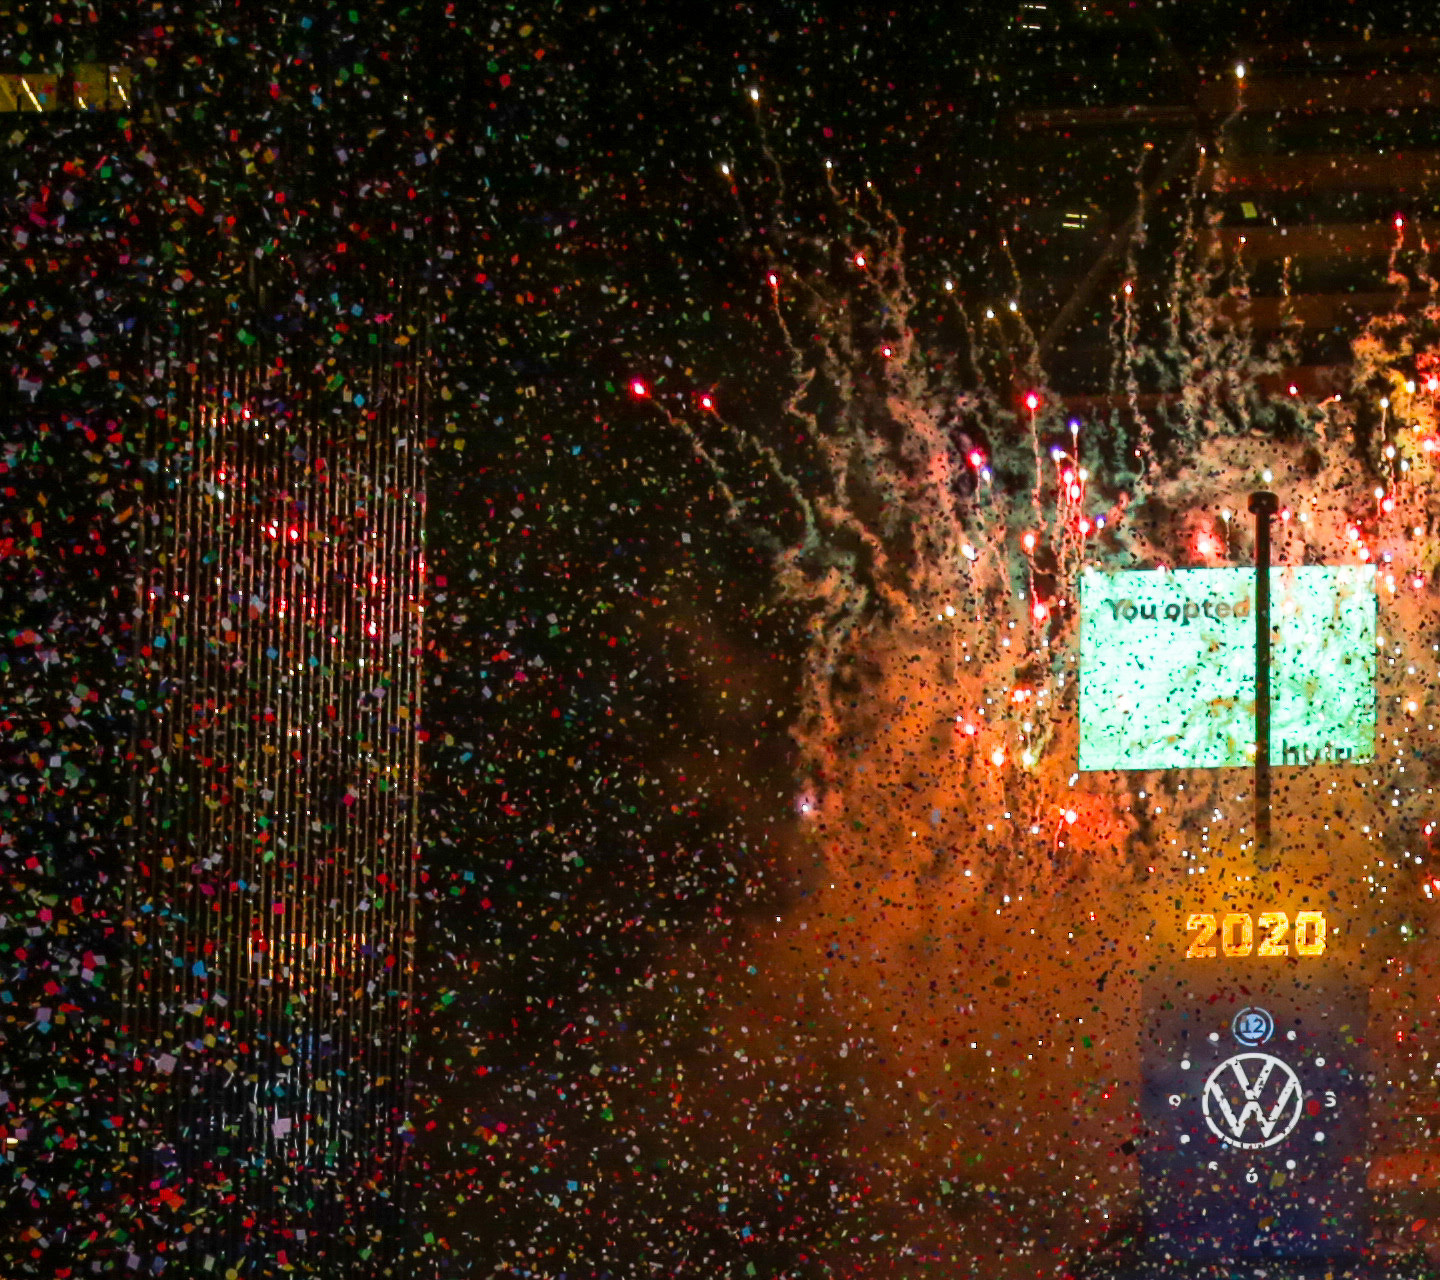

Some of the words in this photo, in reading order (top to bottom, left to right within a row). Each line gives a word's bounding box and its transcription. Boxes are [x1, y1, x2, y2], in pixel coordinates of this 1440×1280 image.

[1107, 598, 1158, 622] You
[1165, 597, 1251, 626] opted
[1186, 911, 1327, 958] 2020
